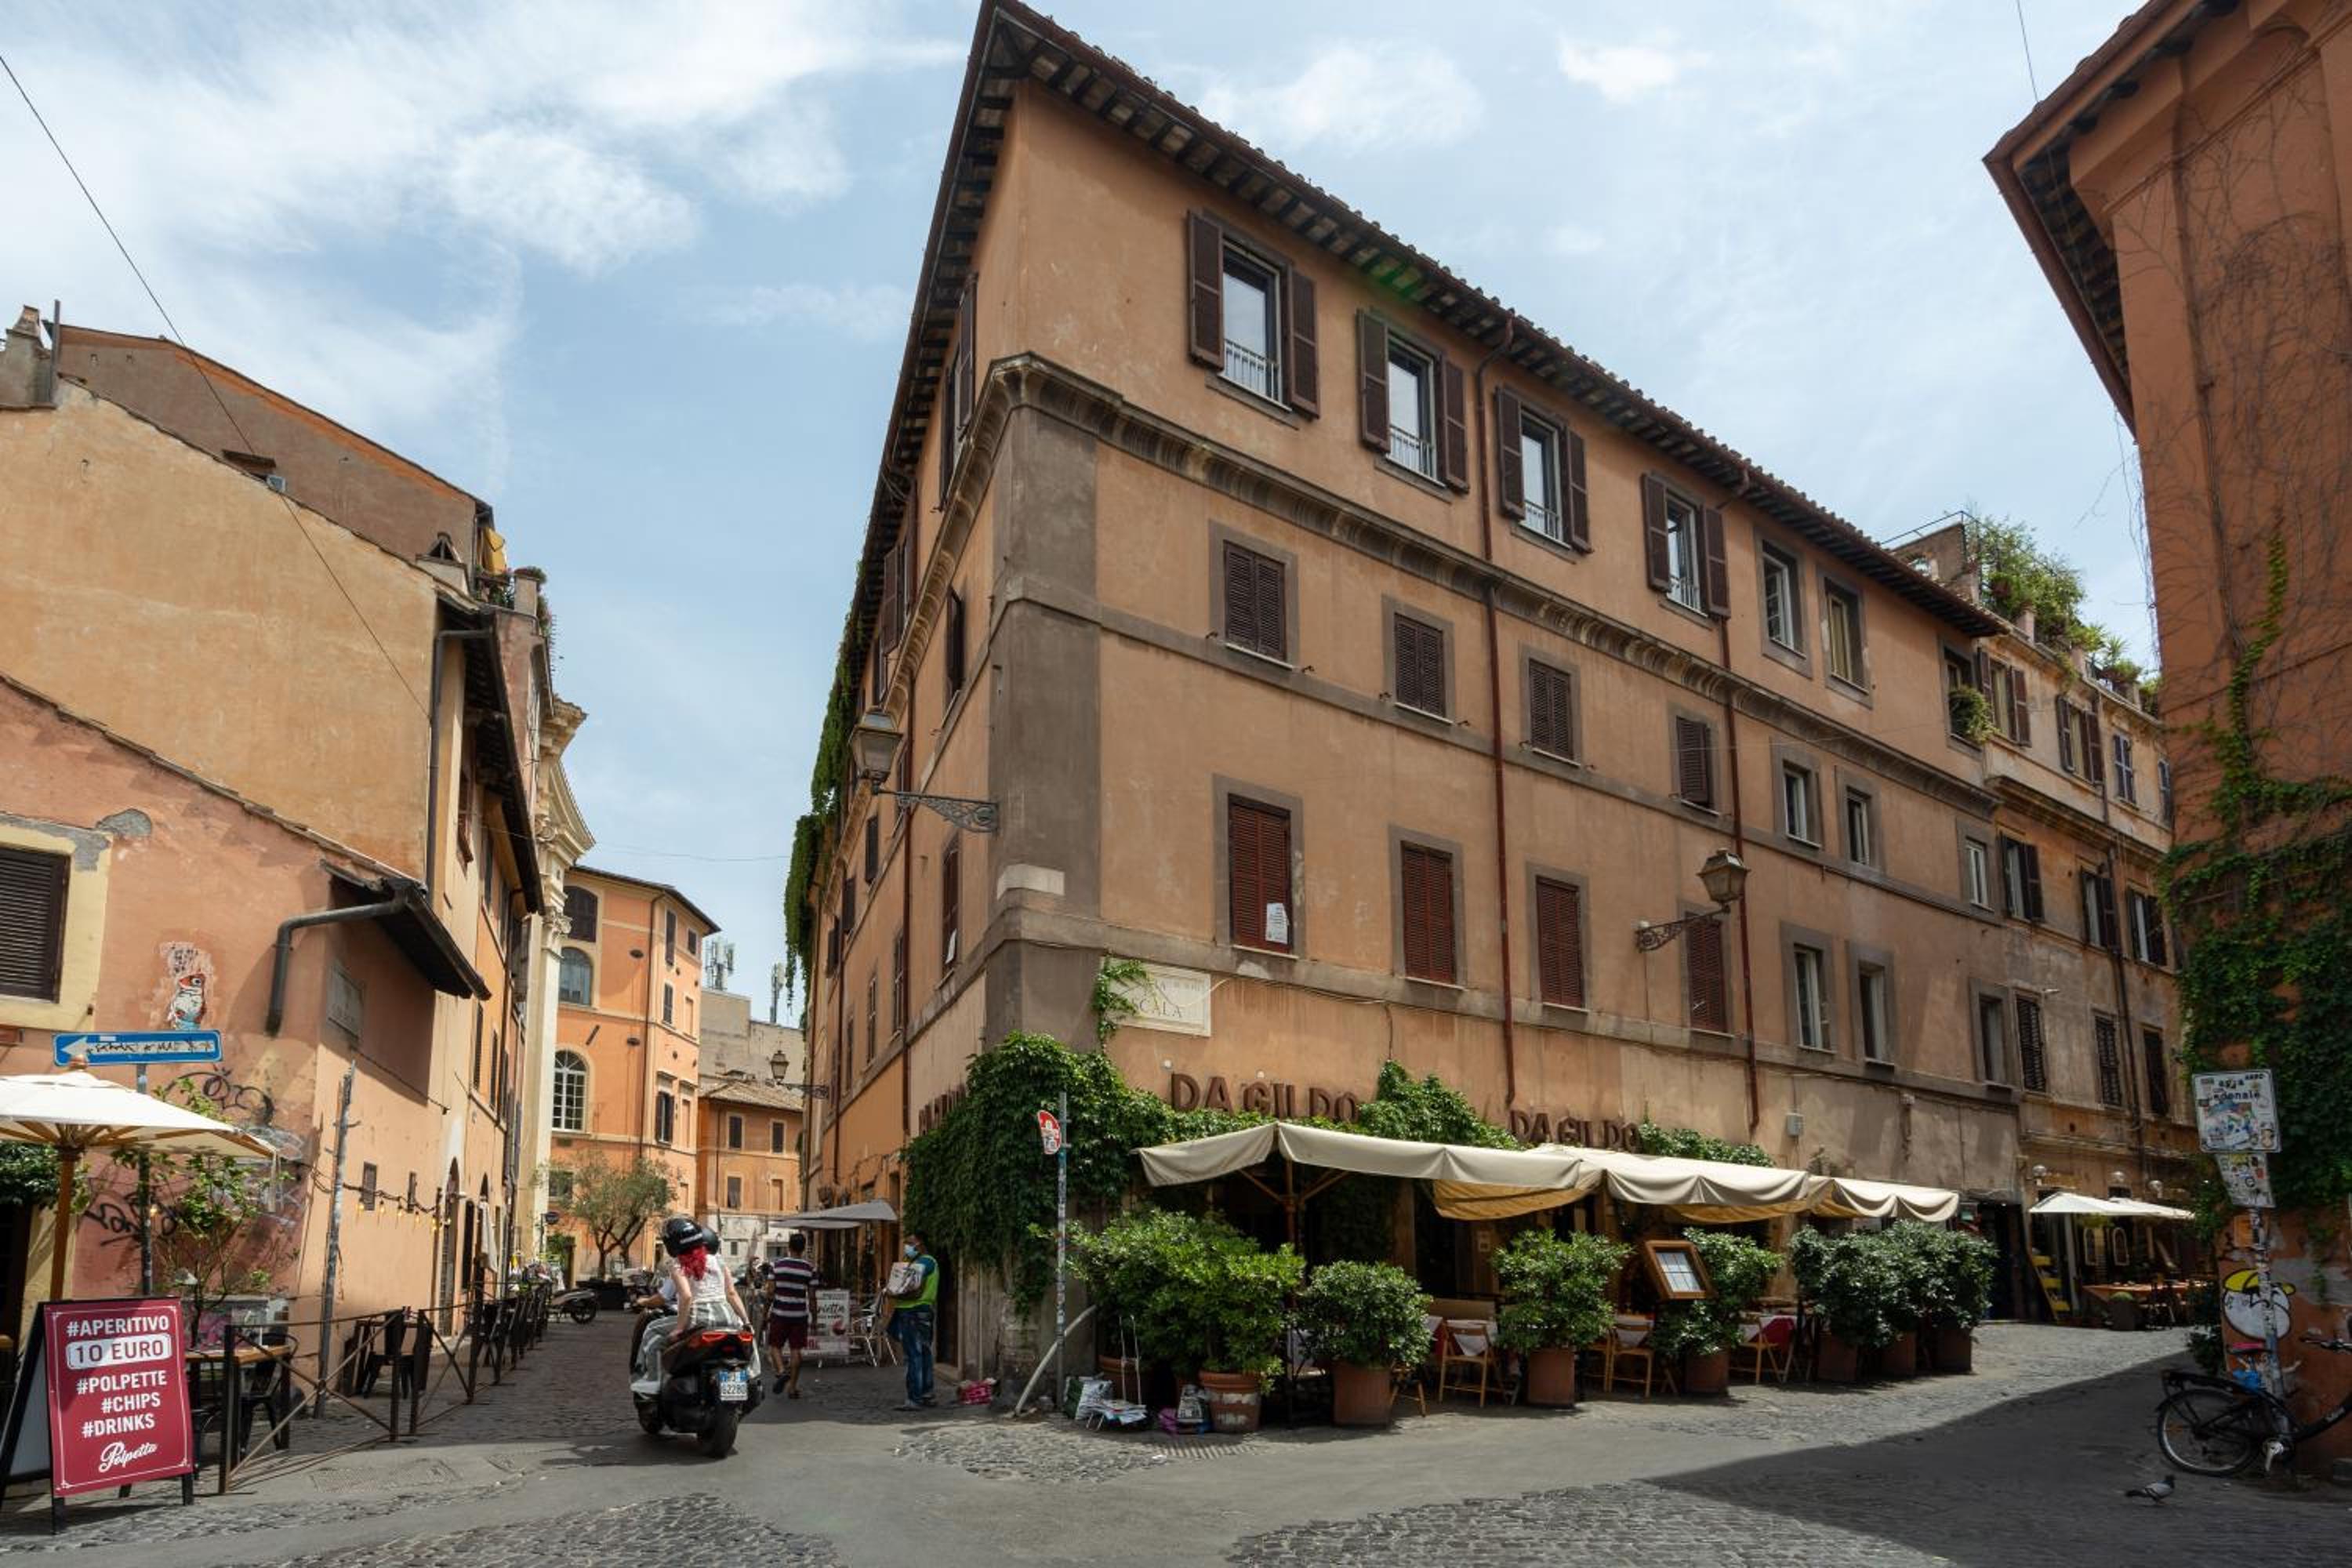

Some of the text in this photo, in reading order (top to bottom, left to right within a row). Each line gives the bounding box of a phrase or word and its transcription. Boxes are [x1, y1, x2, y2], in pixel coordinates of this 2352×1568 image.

[1171, 1071, 1234, 1116] DA
[1508, 1109, 1553, 1144] DA
[67, 1315, 169, 1337] #APERITIVO
[74, 1340, 164, 1363] 10 EURO
[76, 1370, 167, 1395] #POLPETTE
[101, 1392, 161, 1414] #CHIPS
[81, 1413, 155, 1439] #DRINKS
